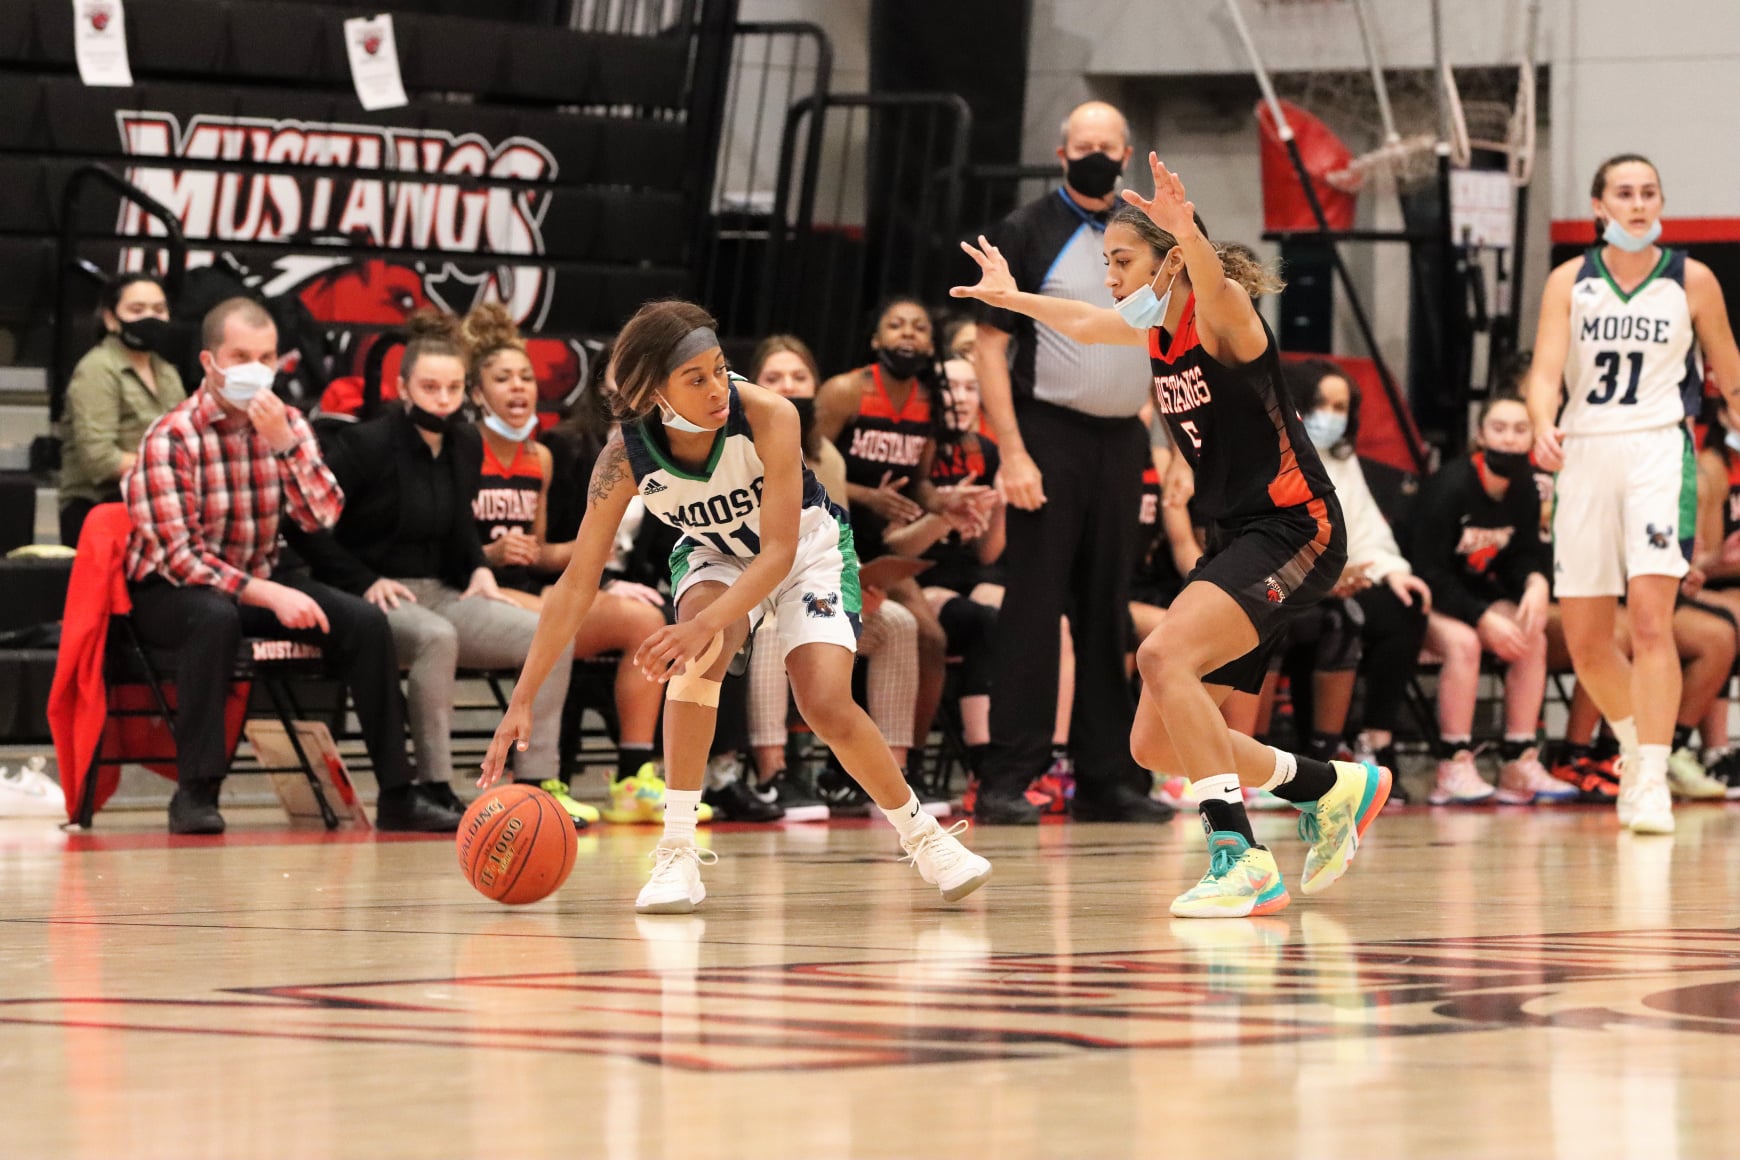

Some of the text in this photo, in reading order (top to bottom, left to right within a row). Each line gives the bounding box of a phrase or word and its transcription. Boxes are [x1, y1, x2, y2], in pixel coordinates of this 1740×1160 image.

[117, 110, 557, 315] MUSTANGS
[1580, 315, 1670, 343] MOOSE
[1153, 364, 1212, 414] USTANGS
[1586, 350, 1644, 405] 31
[849, 427, 928, 466] MUSTAN
[471, 488, 539, 522] MUSTAN
[252, 640, 323, 661] MUSTAN
[490, 818, 523, 864] 1000
